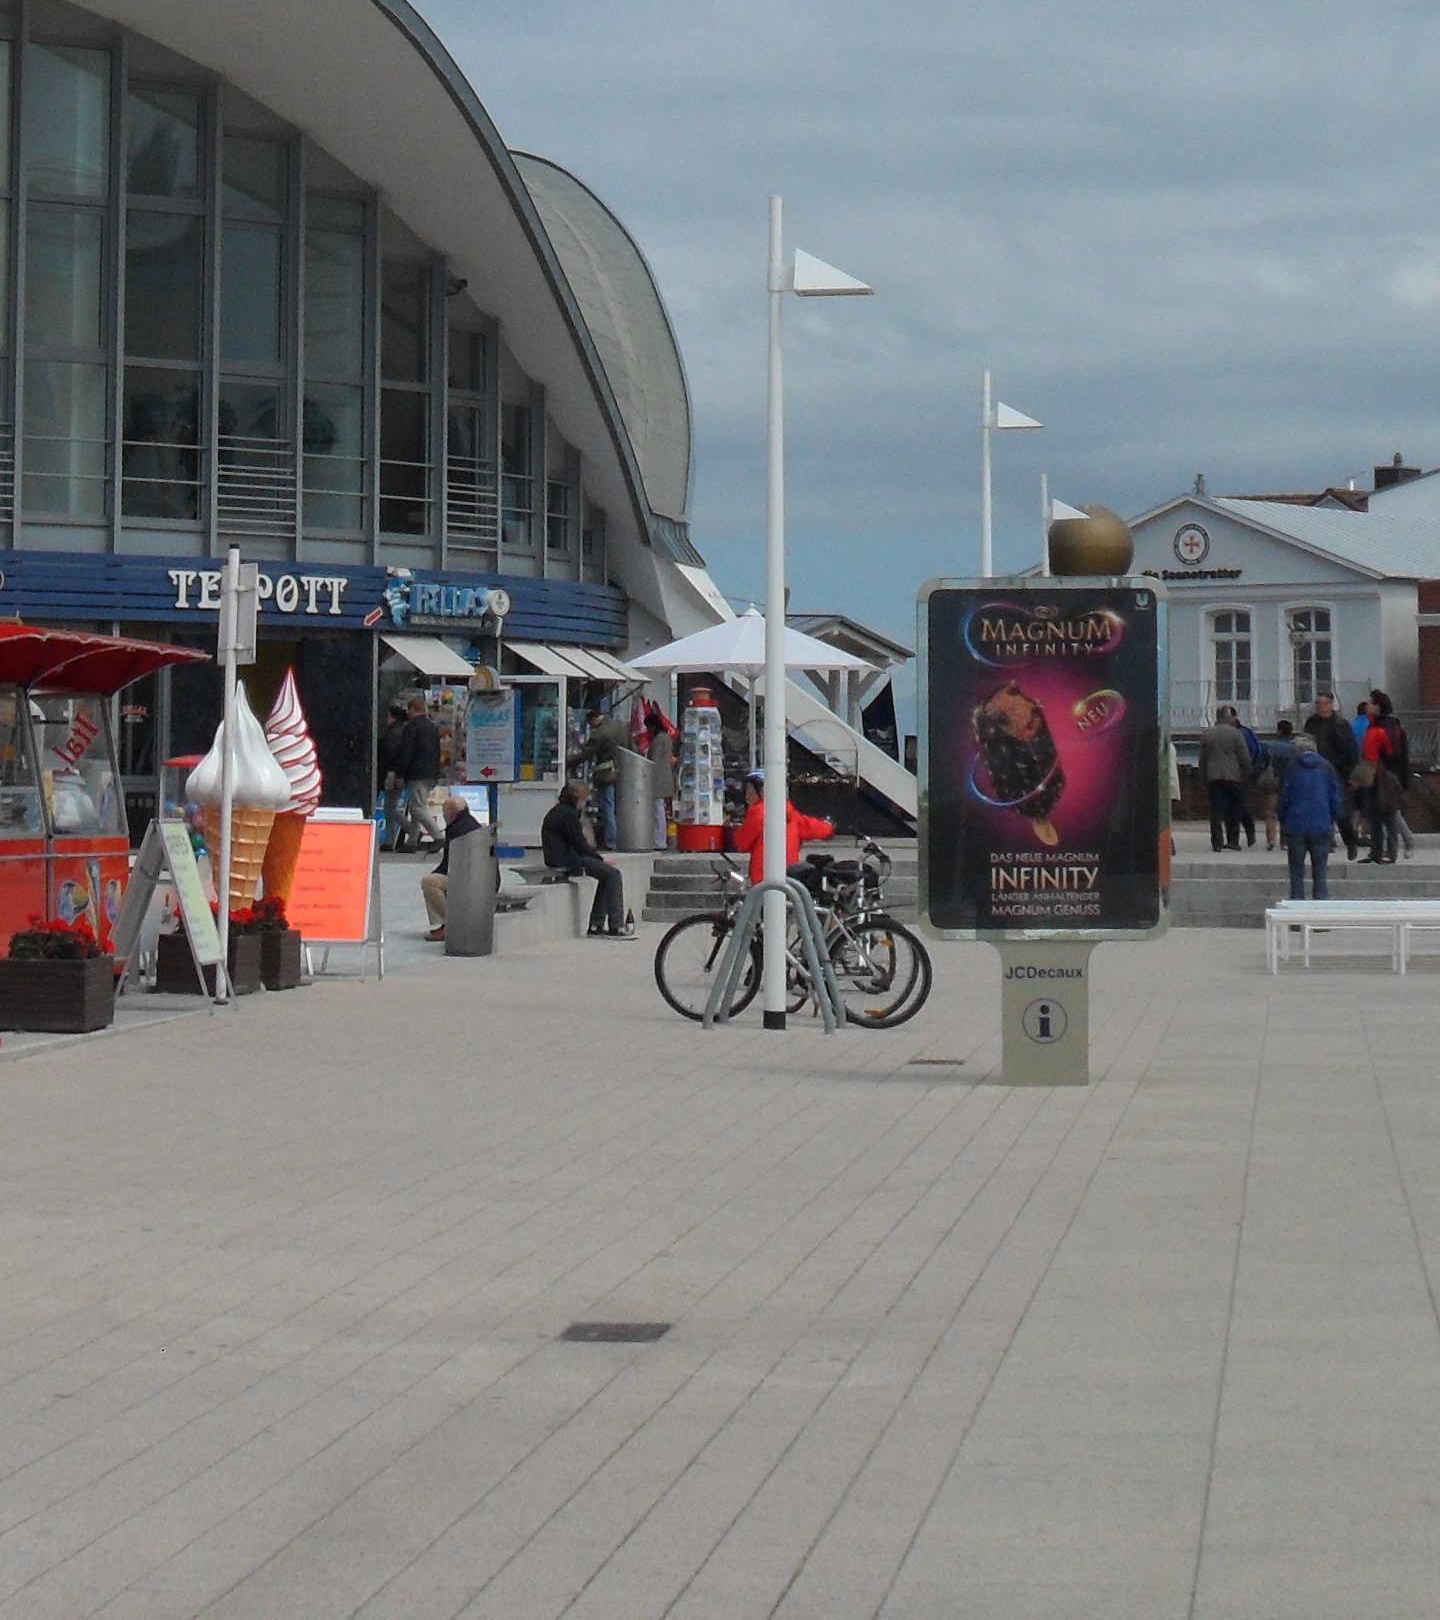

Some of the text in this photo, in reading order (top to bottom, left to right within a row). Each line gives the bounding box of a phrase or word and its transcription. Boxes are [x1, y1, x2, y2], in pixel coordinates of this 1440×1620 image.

[168, 569, 348, 615] TEPOTT
[981, 617, 1111, 642] MAGNUM
[996, 642, 1095, 656] INFINITY
[1076, 701, 1110, 731] NEU
[990, 852, 1100, 863] DAS NEUE MAGNUM
[991, 866, 1099, 890] INFINITY
[991, 904, 1101, 916] MAGNUM GENUSS
[1005, 966, 1084, 979] JCDecaux
